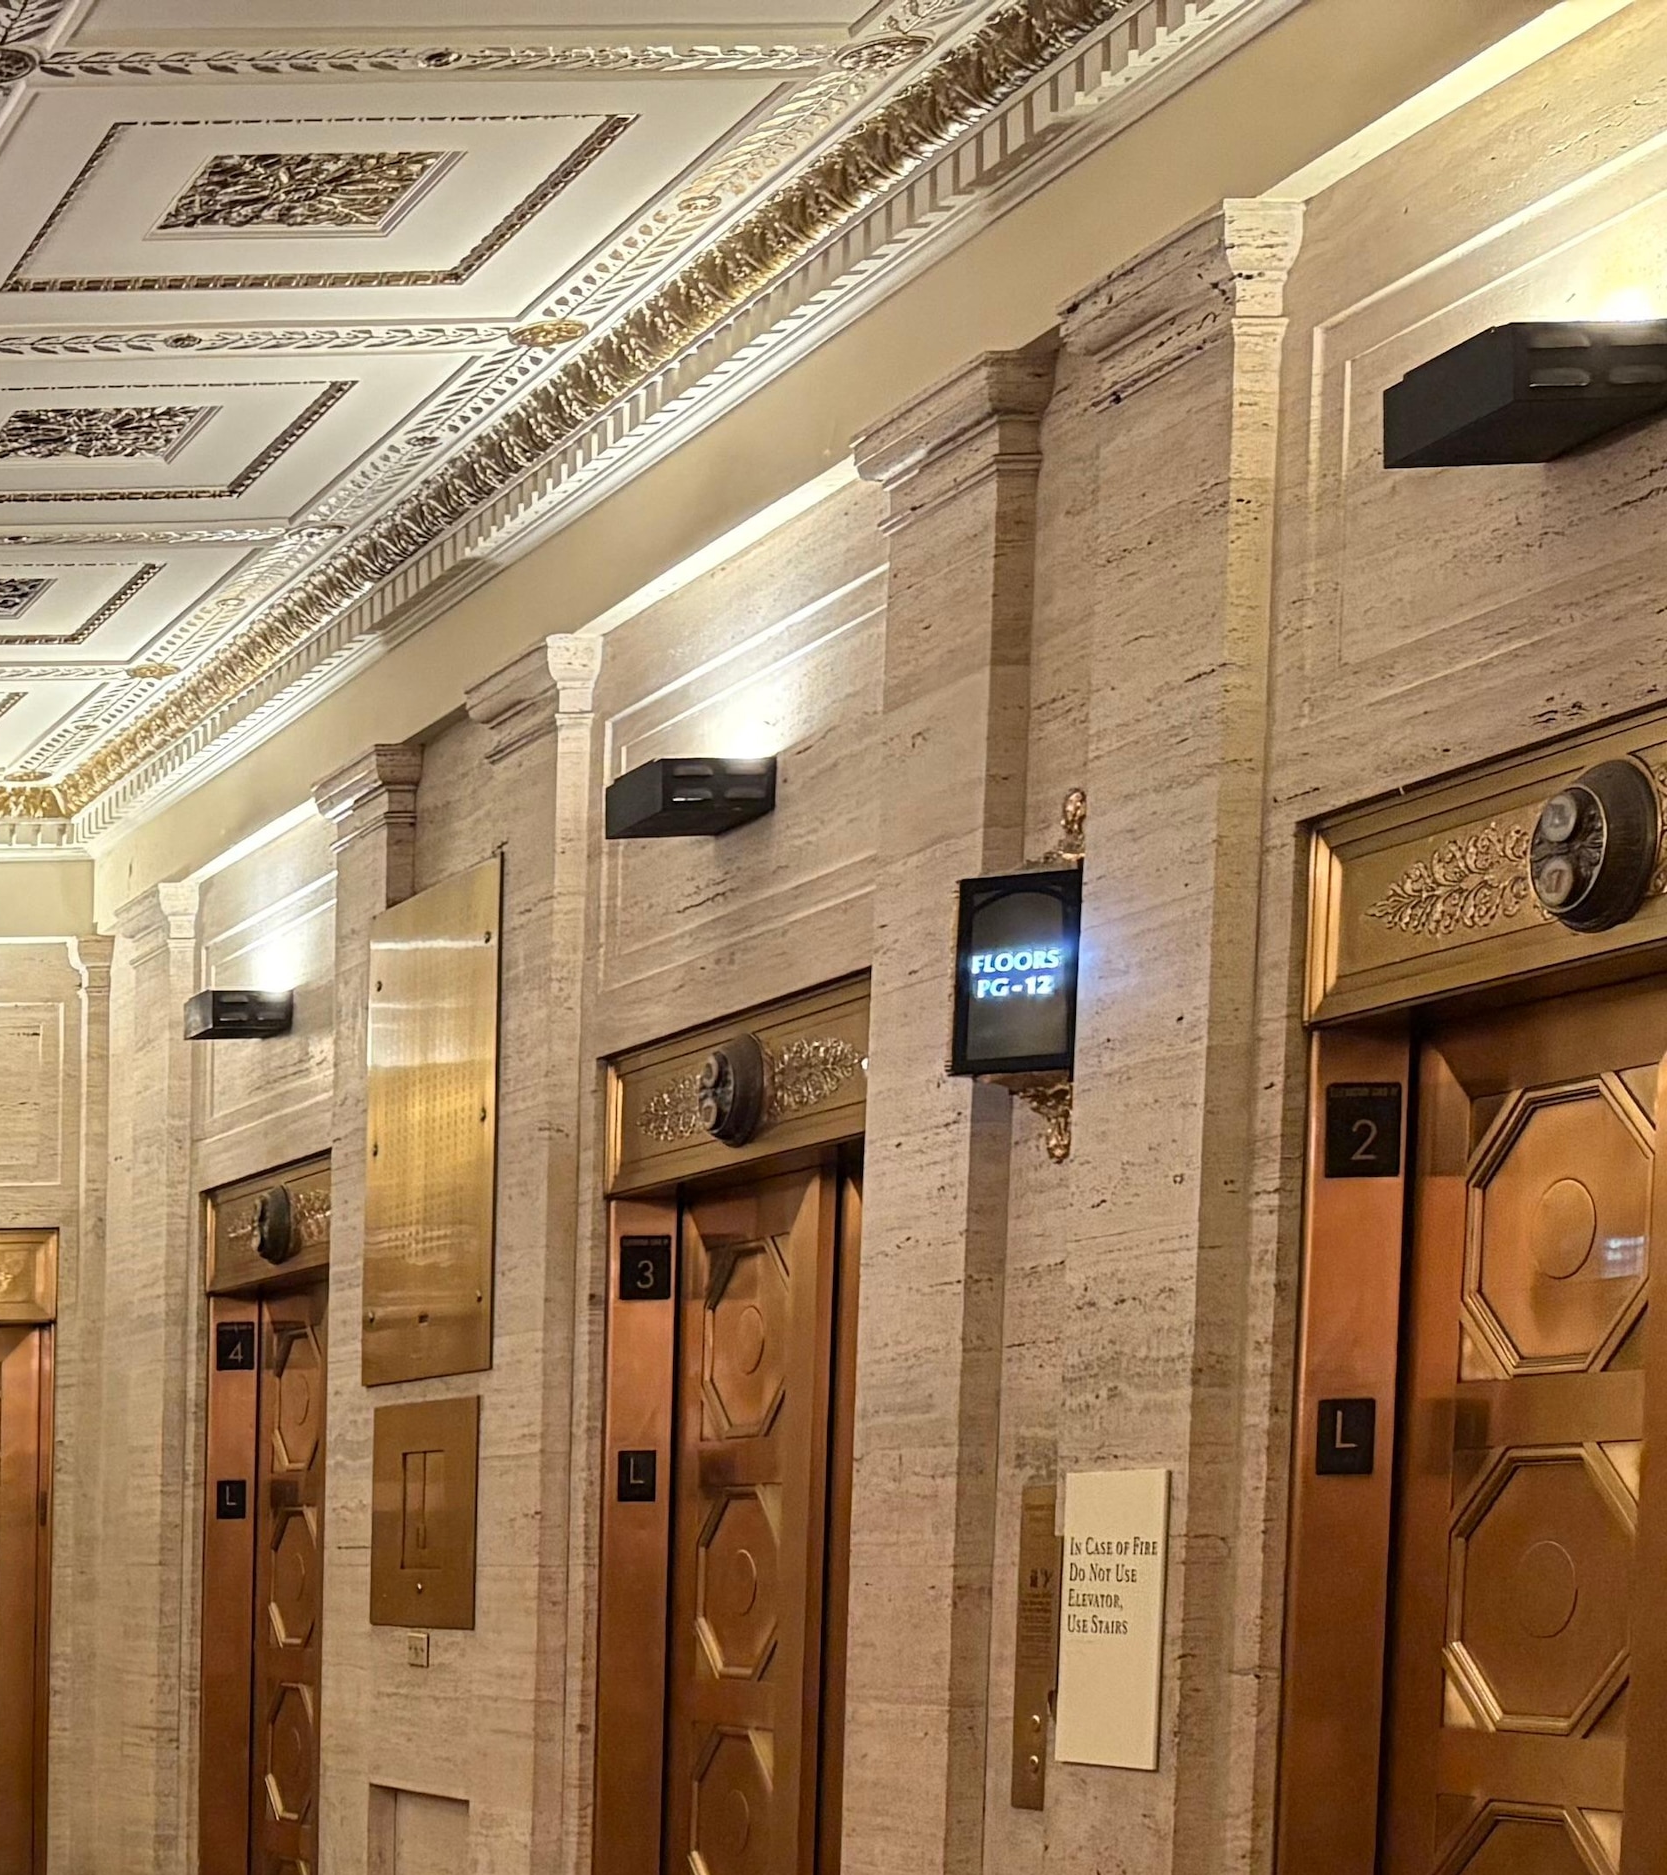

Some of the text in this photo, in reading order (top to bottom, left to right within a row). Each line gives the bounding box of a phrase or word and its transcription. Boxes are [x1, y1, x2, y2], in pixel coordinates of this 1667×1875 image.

[971, 949, 1060, 974] FLOORS
[1351, 1119, 1377, 1160] 2
[636, 1260, 654, 1288] 3
[228, 1341, 243, 1363] 4
[1335, 1410, 1358, 1448] L
[629, 1457, 645, 1484] L
[226, 1485, 237, 1506] L
[1070, 1536, 1158, 1556] IN CASE OF FIRE
[1069, 1562, 1137, 1583] DO NOT USE
[1068, 1588, 1123, 1611] ELEVATOR,
[1067, 1614, 1128, 1635] USE STAIRS
